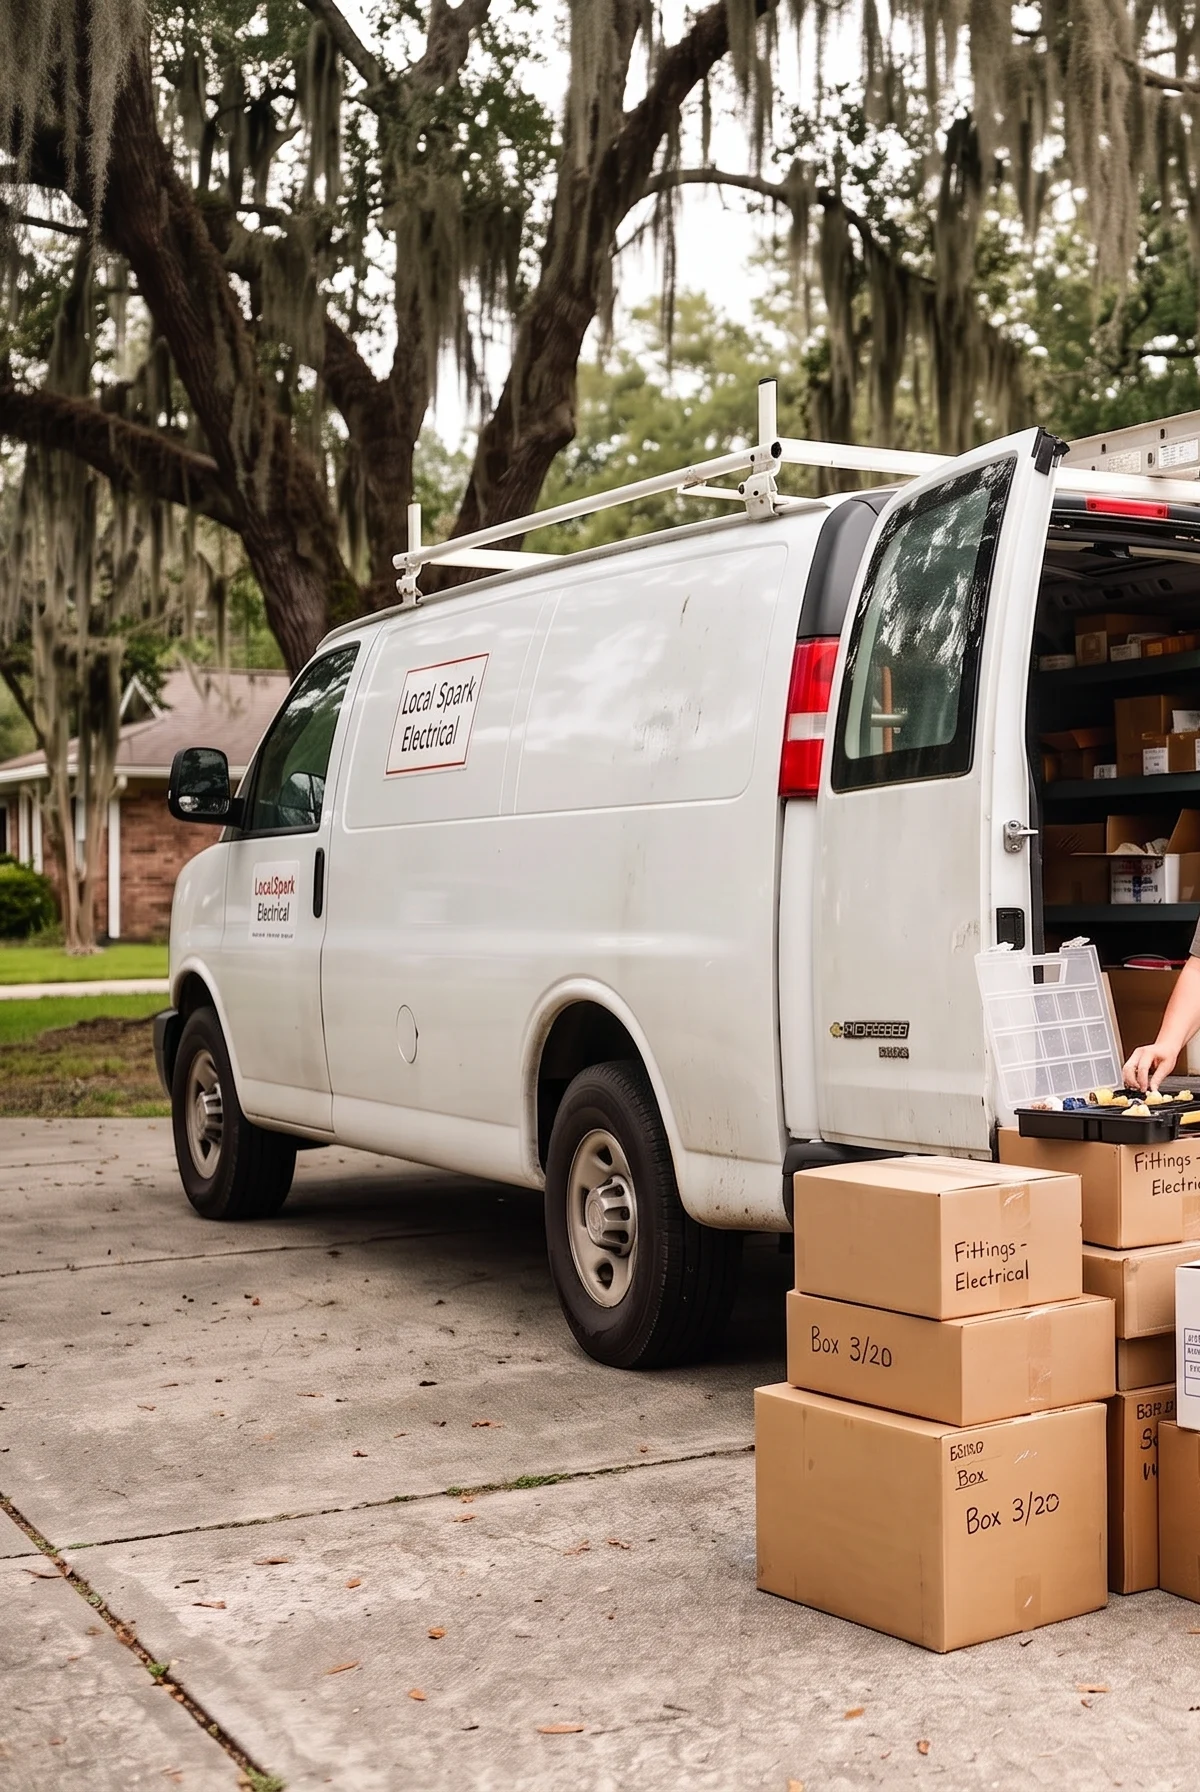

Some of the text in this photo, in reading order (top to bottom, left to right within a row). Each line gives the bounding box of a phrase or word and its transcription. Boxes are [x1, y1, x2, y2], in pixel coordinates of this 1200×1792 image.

[401, 675, 477, 715] Local Spark
[401, 715, 461, 752] Electrical
[1134, 1151, 1191, 1174] Fittings
[954, 1240, 1016, 1263] Fittings
[955, 1259, 1029, 1292] Electrical
[811, 1325, 893, 1368] Box 3/20
[957, 1469, 985, 1488] Box
[966, 1491, 1060, 1535] Box 3/20
